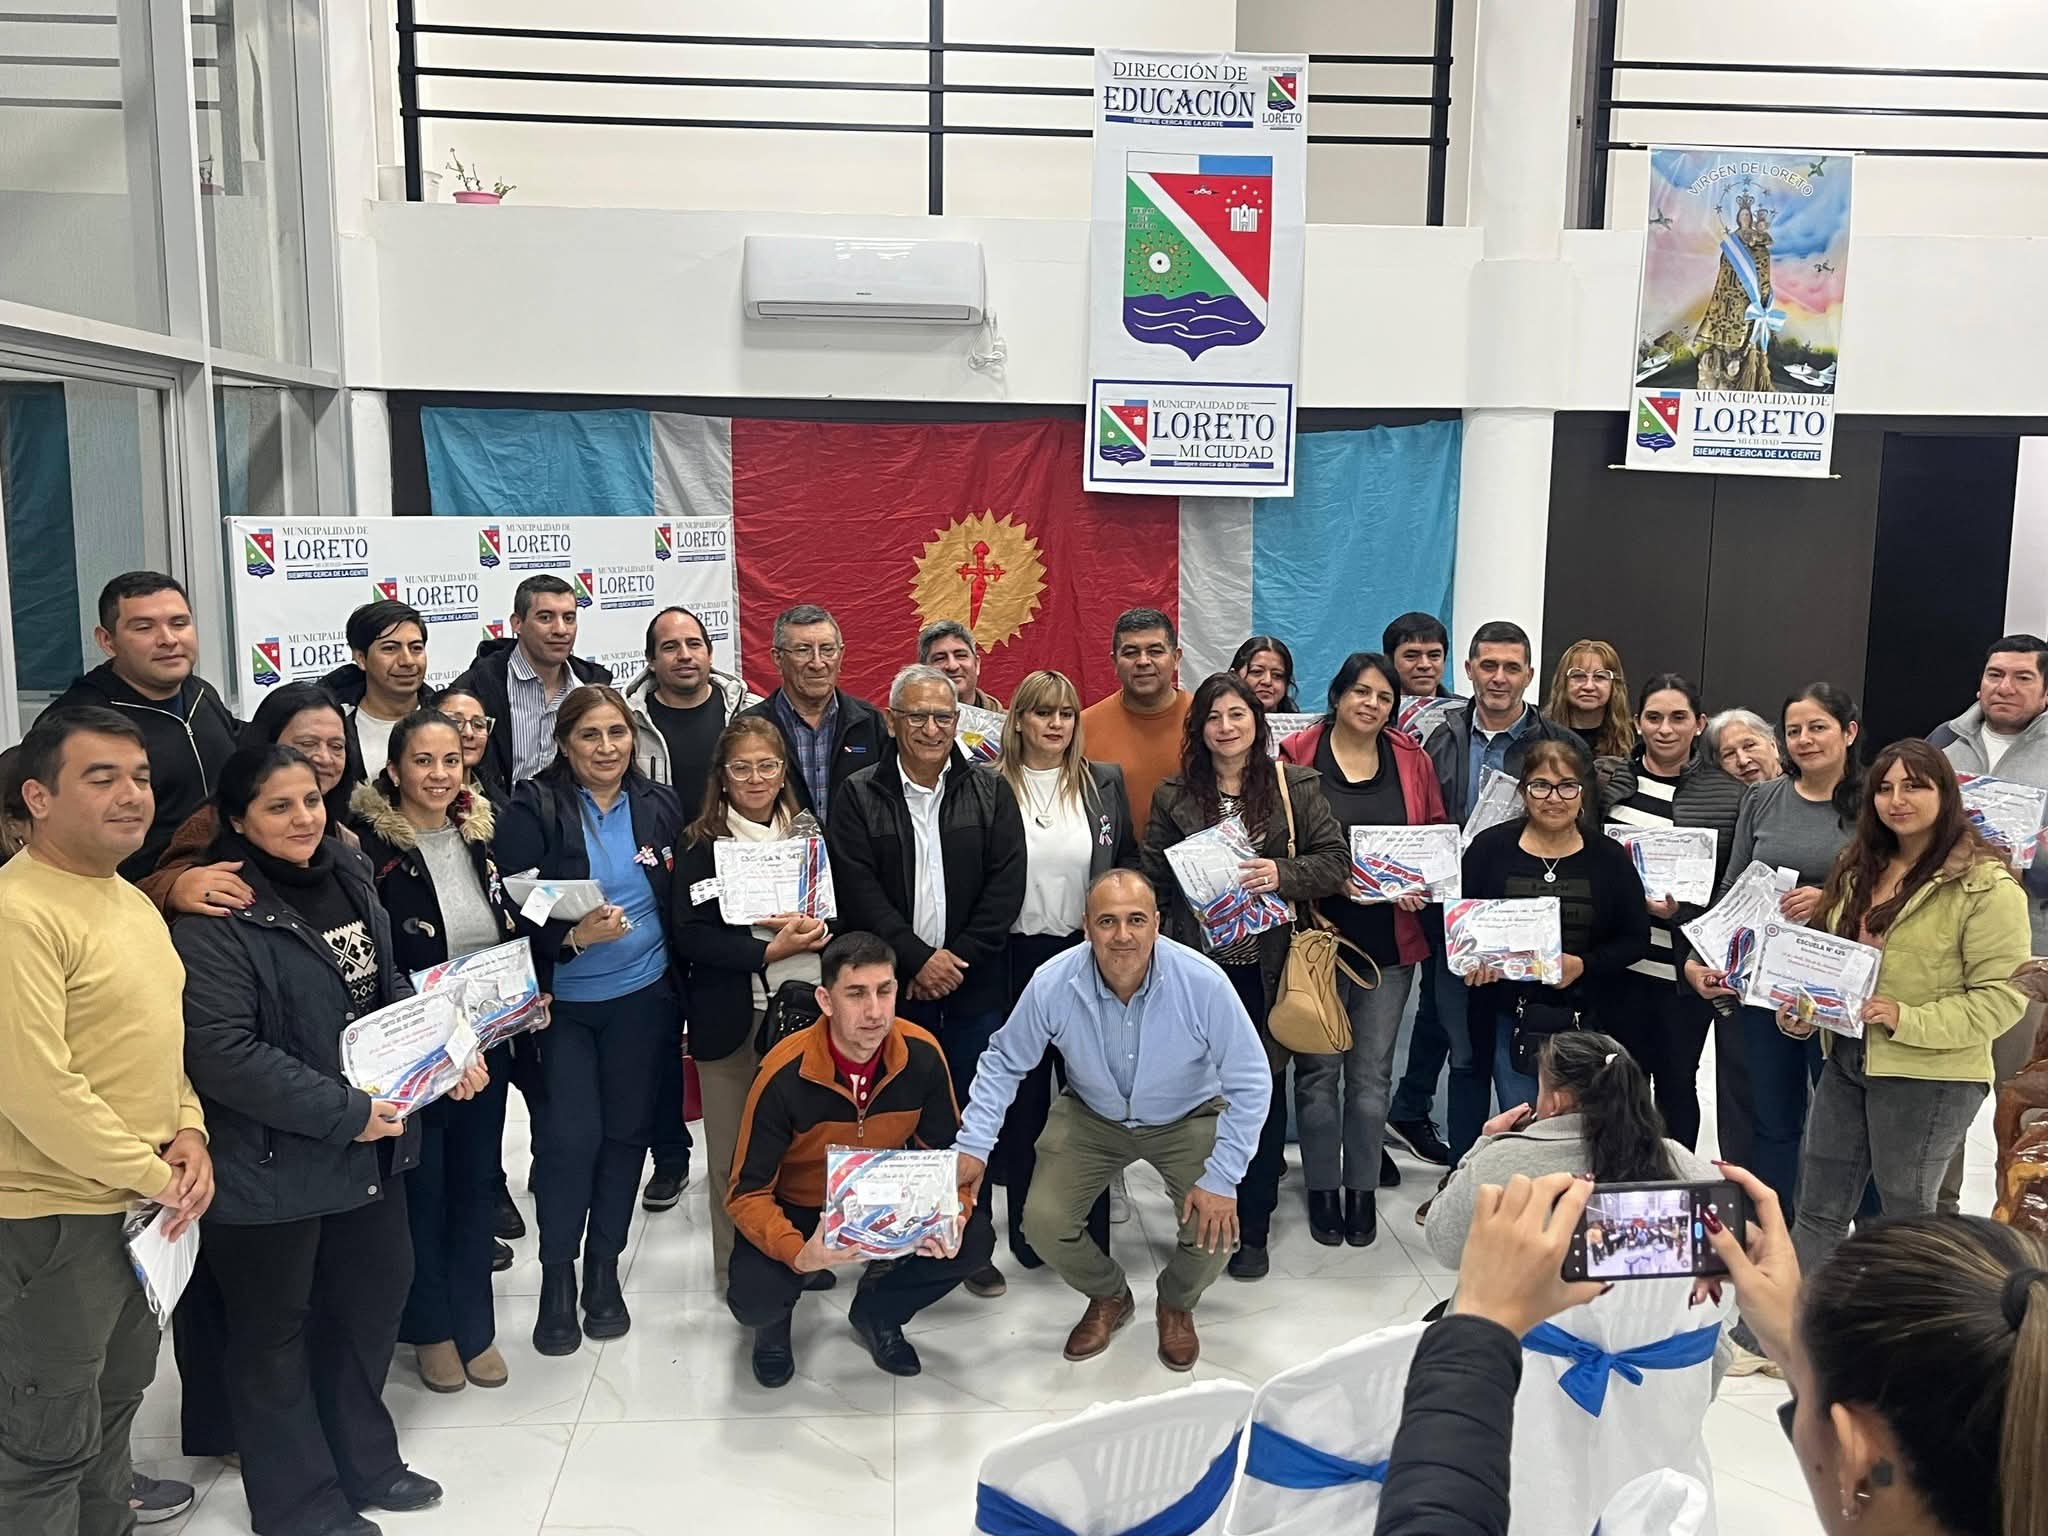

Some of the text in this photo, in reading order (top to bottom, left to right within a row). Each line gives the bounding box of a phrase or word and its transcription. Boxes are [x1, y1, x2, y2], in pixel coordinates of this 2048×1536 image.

[1113, 62, 1248, 81] DIRECCIÓN DE
[1104, 83, 1256, 118] EDUCACIÓN
[1262, 113, 1302, 123] LORETO
[1688, 162, 1813, 196] VIRGEN DE LORETO
[1153, 400, 1250, 410] MUNICIPALIDAD DE
[1694, 391, 1830, 407] MUNICIPALIDAD DE
[1153, 412, 1275, 441] LORETO
[1694, 407, 1825, 436] LORETO
[1179, 444, 1273, 459] MI CIUDAD
[1694, 447, 1820, 460] SIEMPRE CERCA DE LA GENTE
[282, 526, 368, 535] MUNICIPALIDAD DE
[677, 531, 726, 548] LORETO
[284, 538, 368, 560] LORETO
[508, 534, 571, 553] LORETO
[600, 575, 654, 594] LORETO
[406, 584, 478, 606] LORETO
[290, 643, 346, 667] LORE
[1796, 938, 1825, 951] ESCUELA
